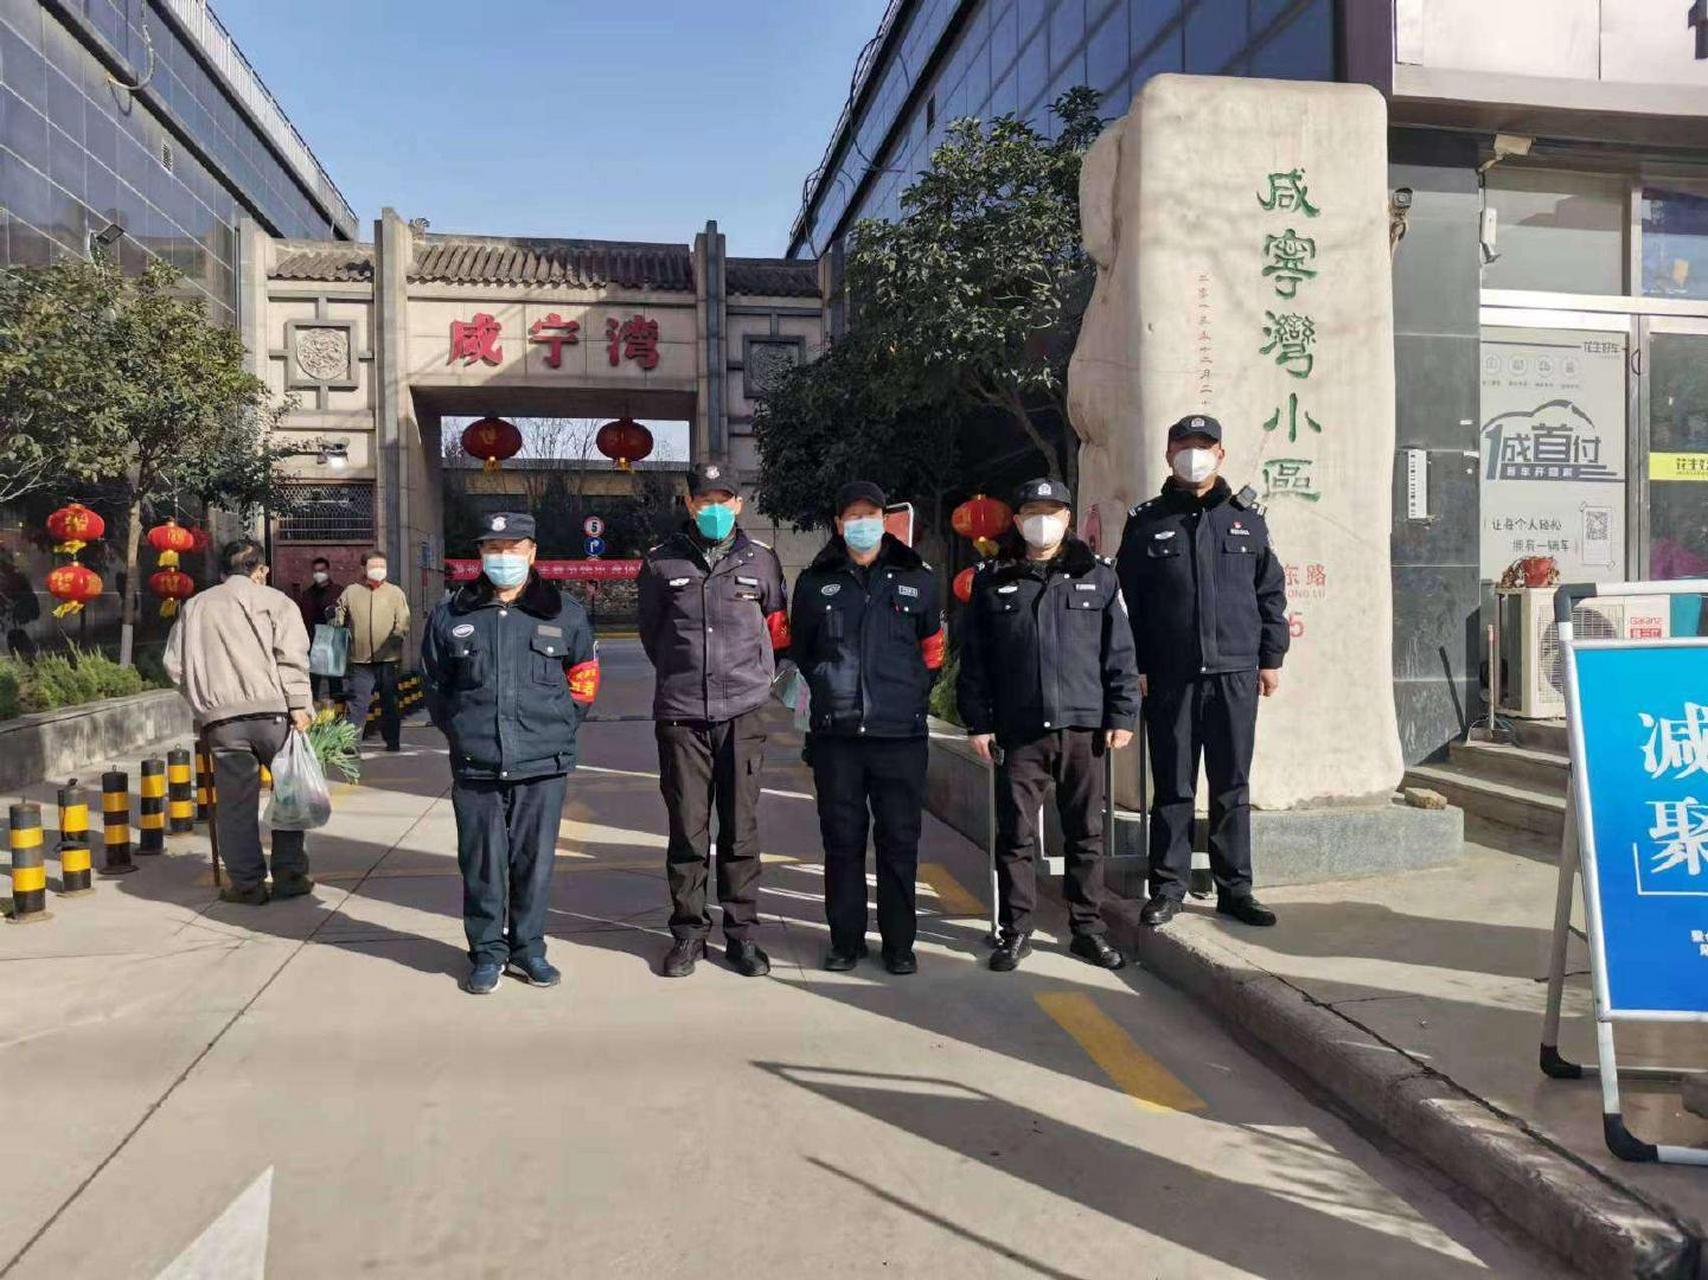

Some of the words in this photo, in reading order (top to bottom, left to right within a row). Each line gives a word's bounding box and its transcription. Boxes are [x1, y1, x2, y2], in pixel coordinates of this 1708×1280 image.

[447, 312, 659, 369] 咸宁湾
[1492, 518, 1563, 531] 让每个人轻松
